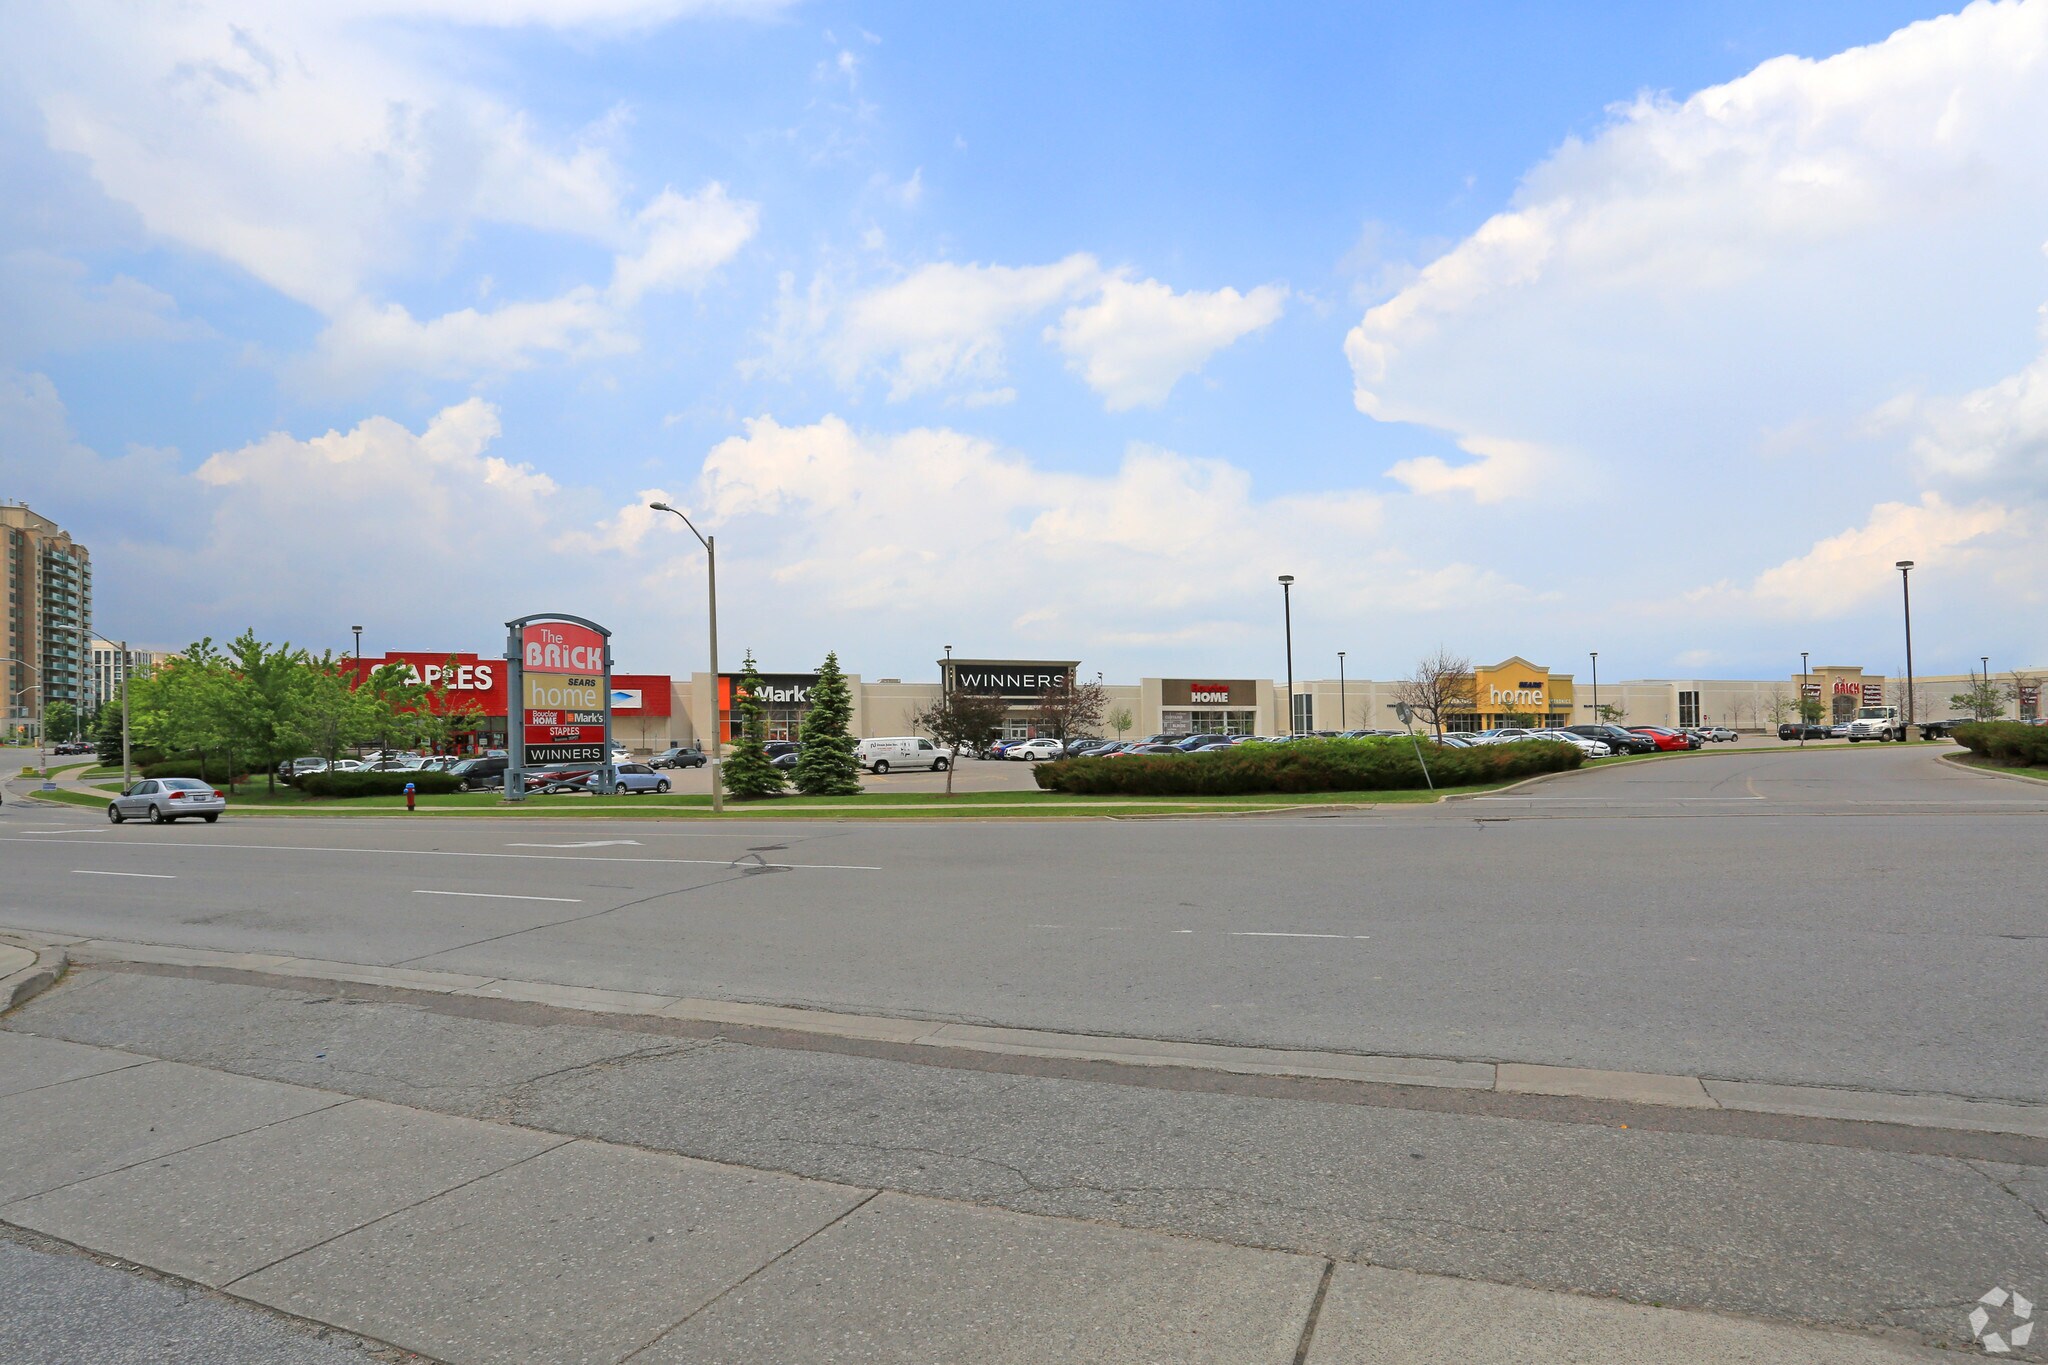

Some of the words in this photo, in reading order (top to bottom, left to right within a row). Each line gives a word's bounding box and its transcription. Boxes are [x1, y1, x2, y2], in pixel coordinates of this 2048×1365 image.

[541, 628, 563, 644] The
[370, 664, 493, 690] APLES
[568, 678, 596, 687] SEARS
[960, 674, 1065, 688] WINNERS
[532, 679, 596, 707] home
[754, 685, 816, 702] Mark'
[1191, 692, 1229, 703] HOME
[1490, 683, 1543, 705] home
[532, 717, 557, 725] HOME
[574, 713, 604, 723] Mark's
[549, 726, 580, 736] STAPLES
[531, 748, 601, 760] WINNERS
